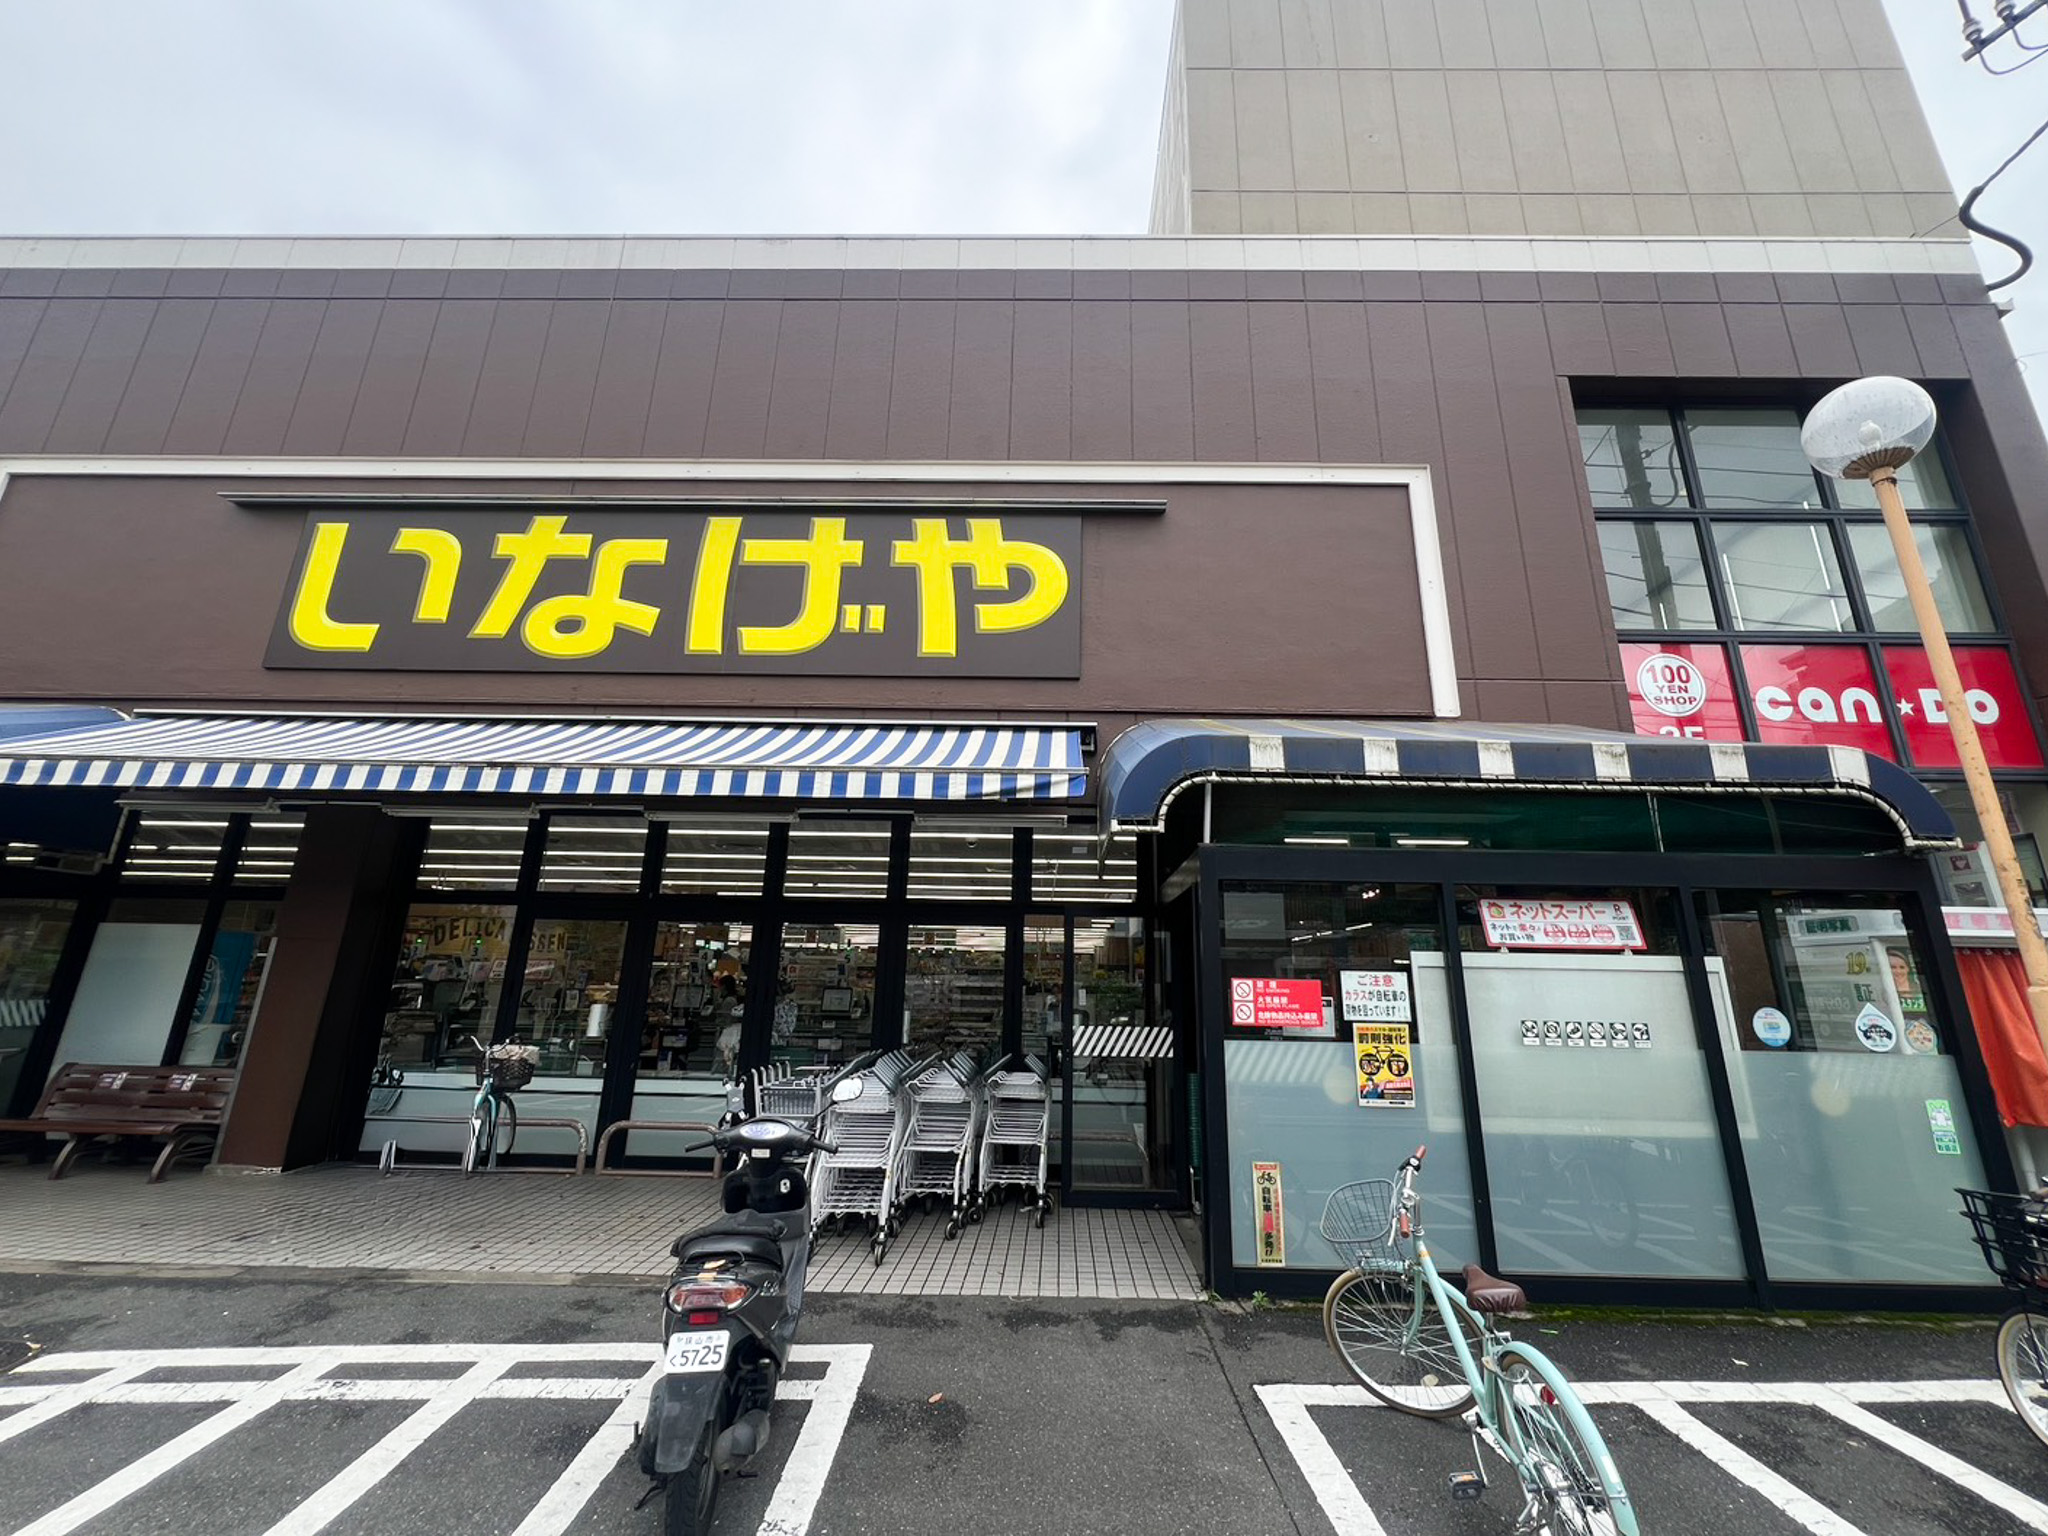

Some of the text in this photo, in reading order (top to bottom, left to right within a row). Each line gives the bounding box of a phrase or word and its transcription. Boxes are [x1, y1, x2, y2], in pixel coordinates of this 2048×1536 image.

[288, 515, 1070, 658] いなげや
[1646, 664, 1691, 684] 100
[1656, 685, 1688, 694] YEN
[1653, 695, 1697, 706] SHOP
[1509, 902, 1606, 920] ネットスーパー
[1357, 974, 1395, 987] ご注意
[1345, 989, 1407, 1002] カラスが自転車の
[1358, 1033, 1406, 1044] 罰則強化
[680, 1344, 724, 1367] 5725
